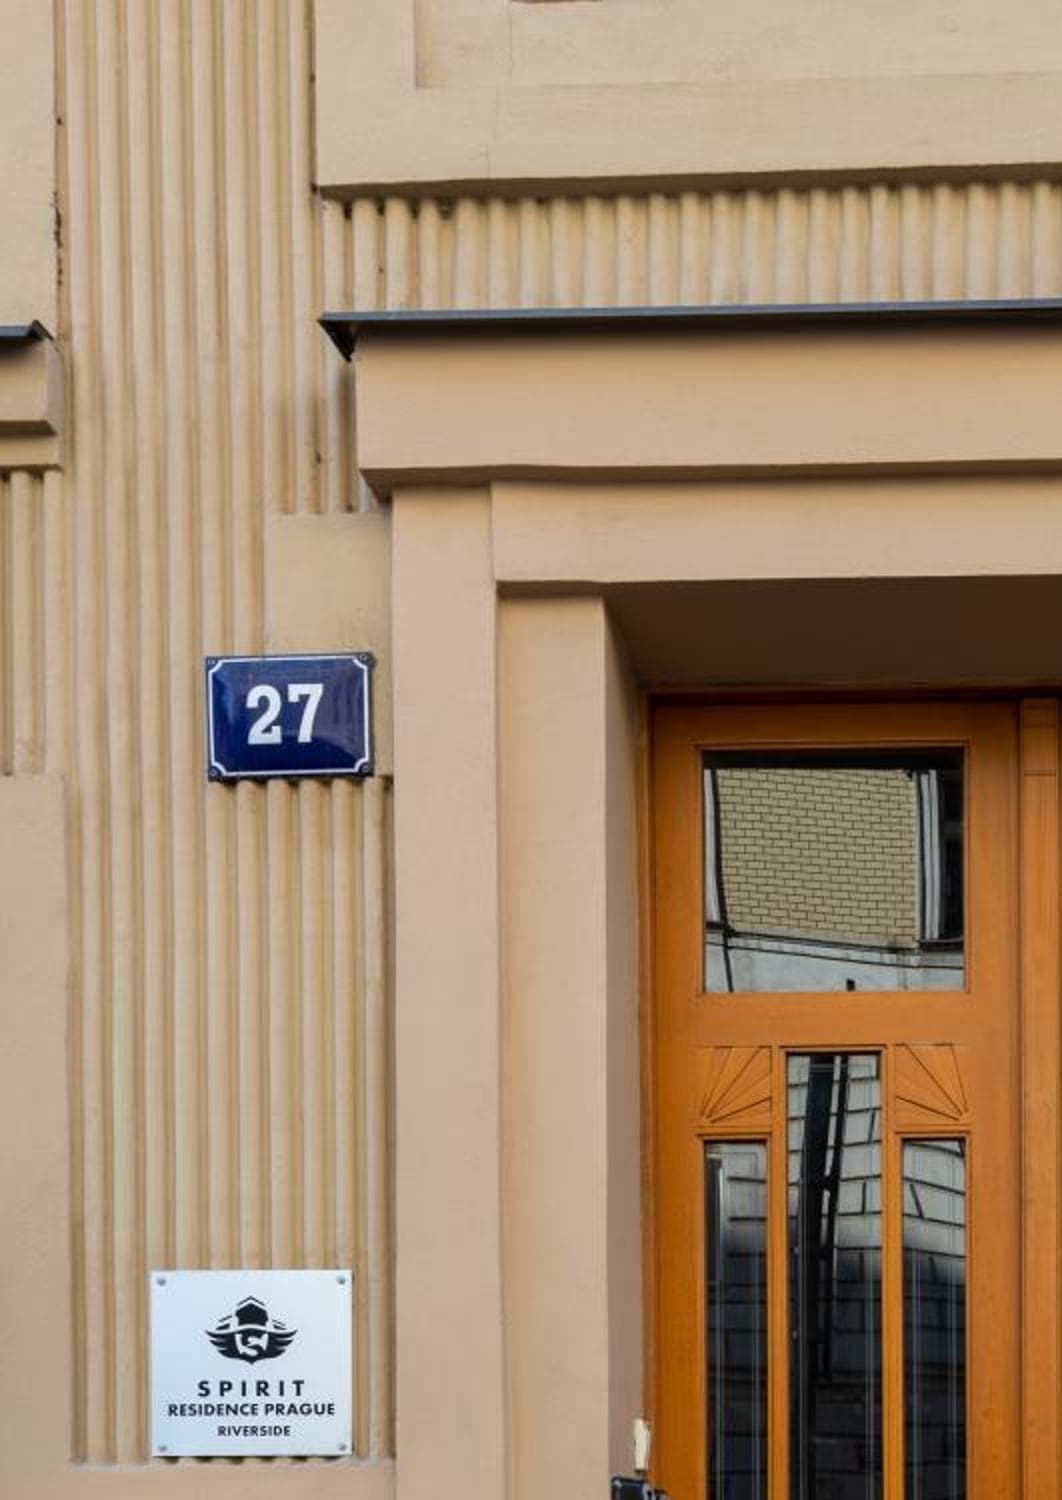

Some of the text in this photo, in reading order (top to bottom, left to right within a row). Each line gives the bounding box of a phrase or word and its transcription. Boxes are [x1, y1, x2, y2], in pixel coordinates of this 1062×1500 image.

[246, 683, 324, 745] 27
[197, 1380, 305, 1397] SPIRIT
[168, 1403, 336, 1417] RESIDENCE PRAGUE
[217, 1425, 291, 1437] RIVERSIDE
